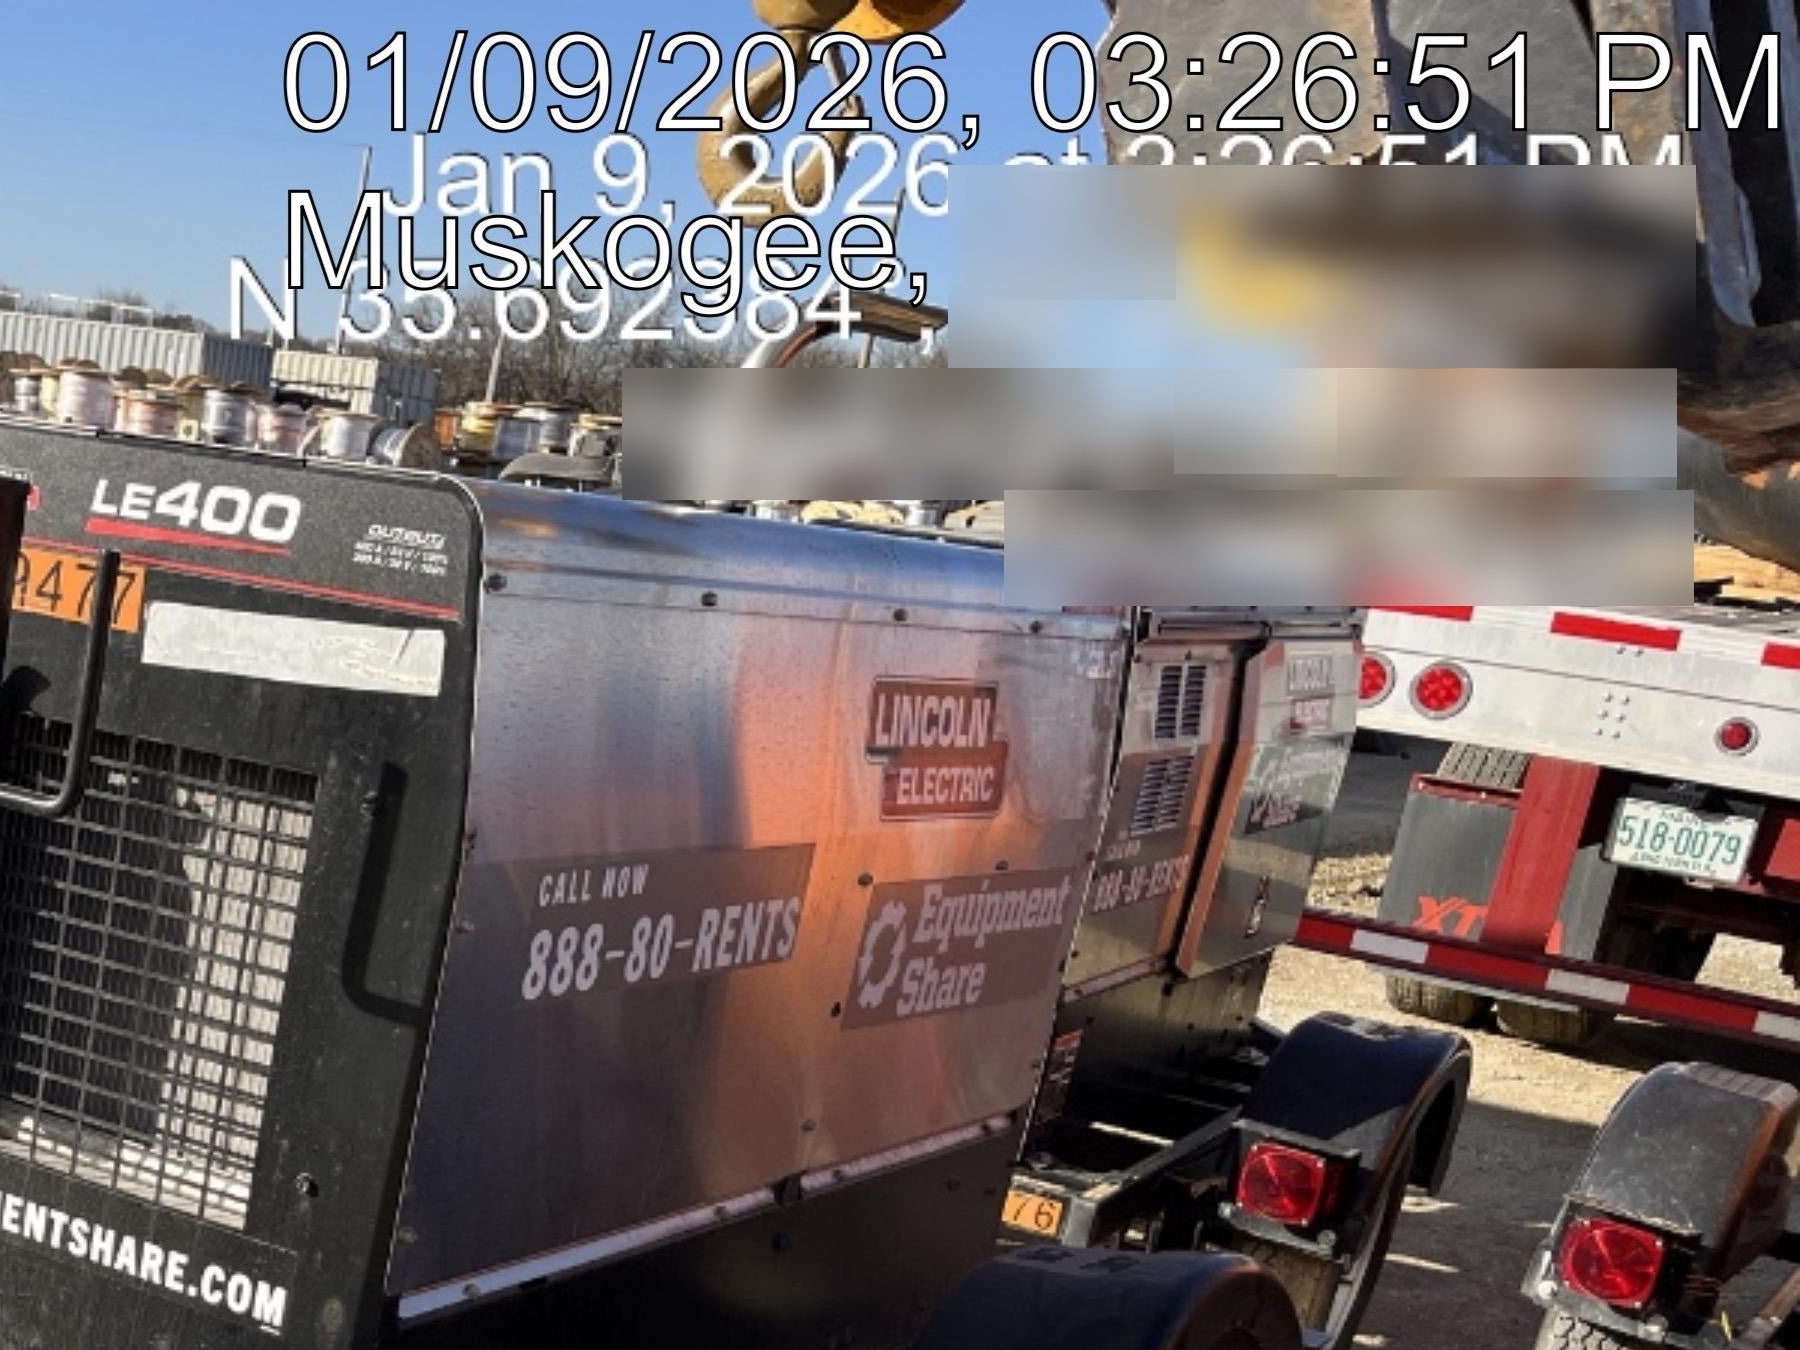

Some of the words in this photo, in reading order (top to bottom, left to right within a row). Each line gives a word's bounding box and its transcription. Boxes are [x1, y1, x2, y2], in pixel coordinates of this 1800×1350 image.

[90, 478, 302, 544] LE400
[874, 692, 992, 748] LINCOLN
[896, 765, 995, 805] ELECTRIC
[1618, 815, 1743, 866] 518-0079
[539, 872, 592, 907] CALL
[602, 863, 650, 897] NOW
[912, 878, 1072, 954] Equipment
[521, 896, 802, 1001] 888-80-RENTS
[896, 959, 986, 1017] Share
